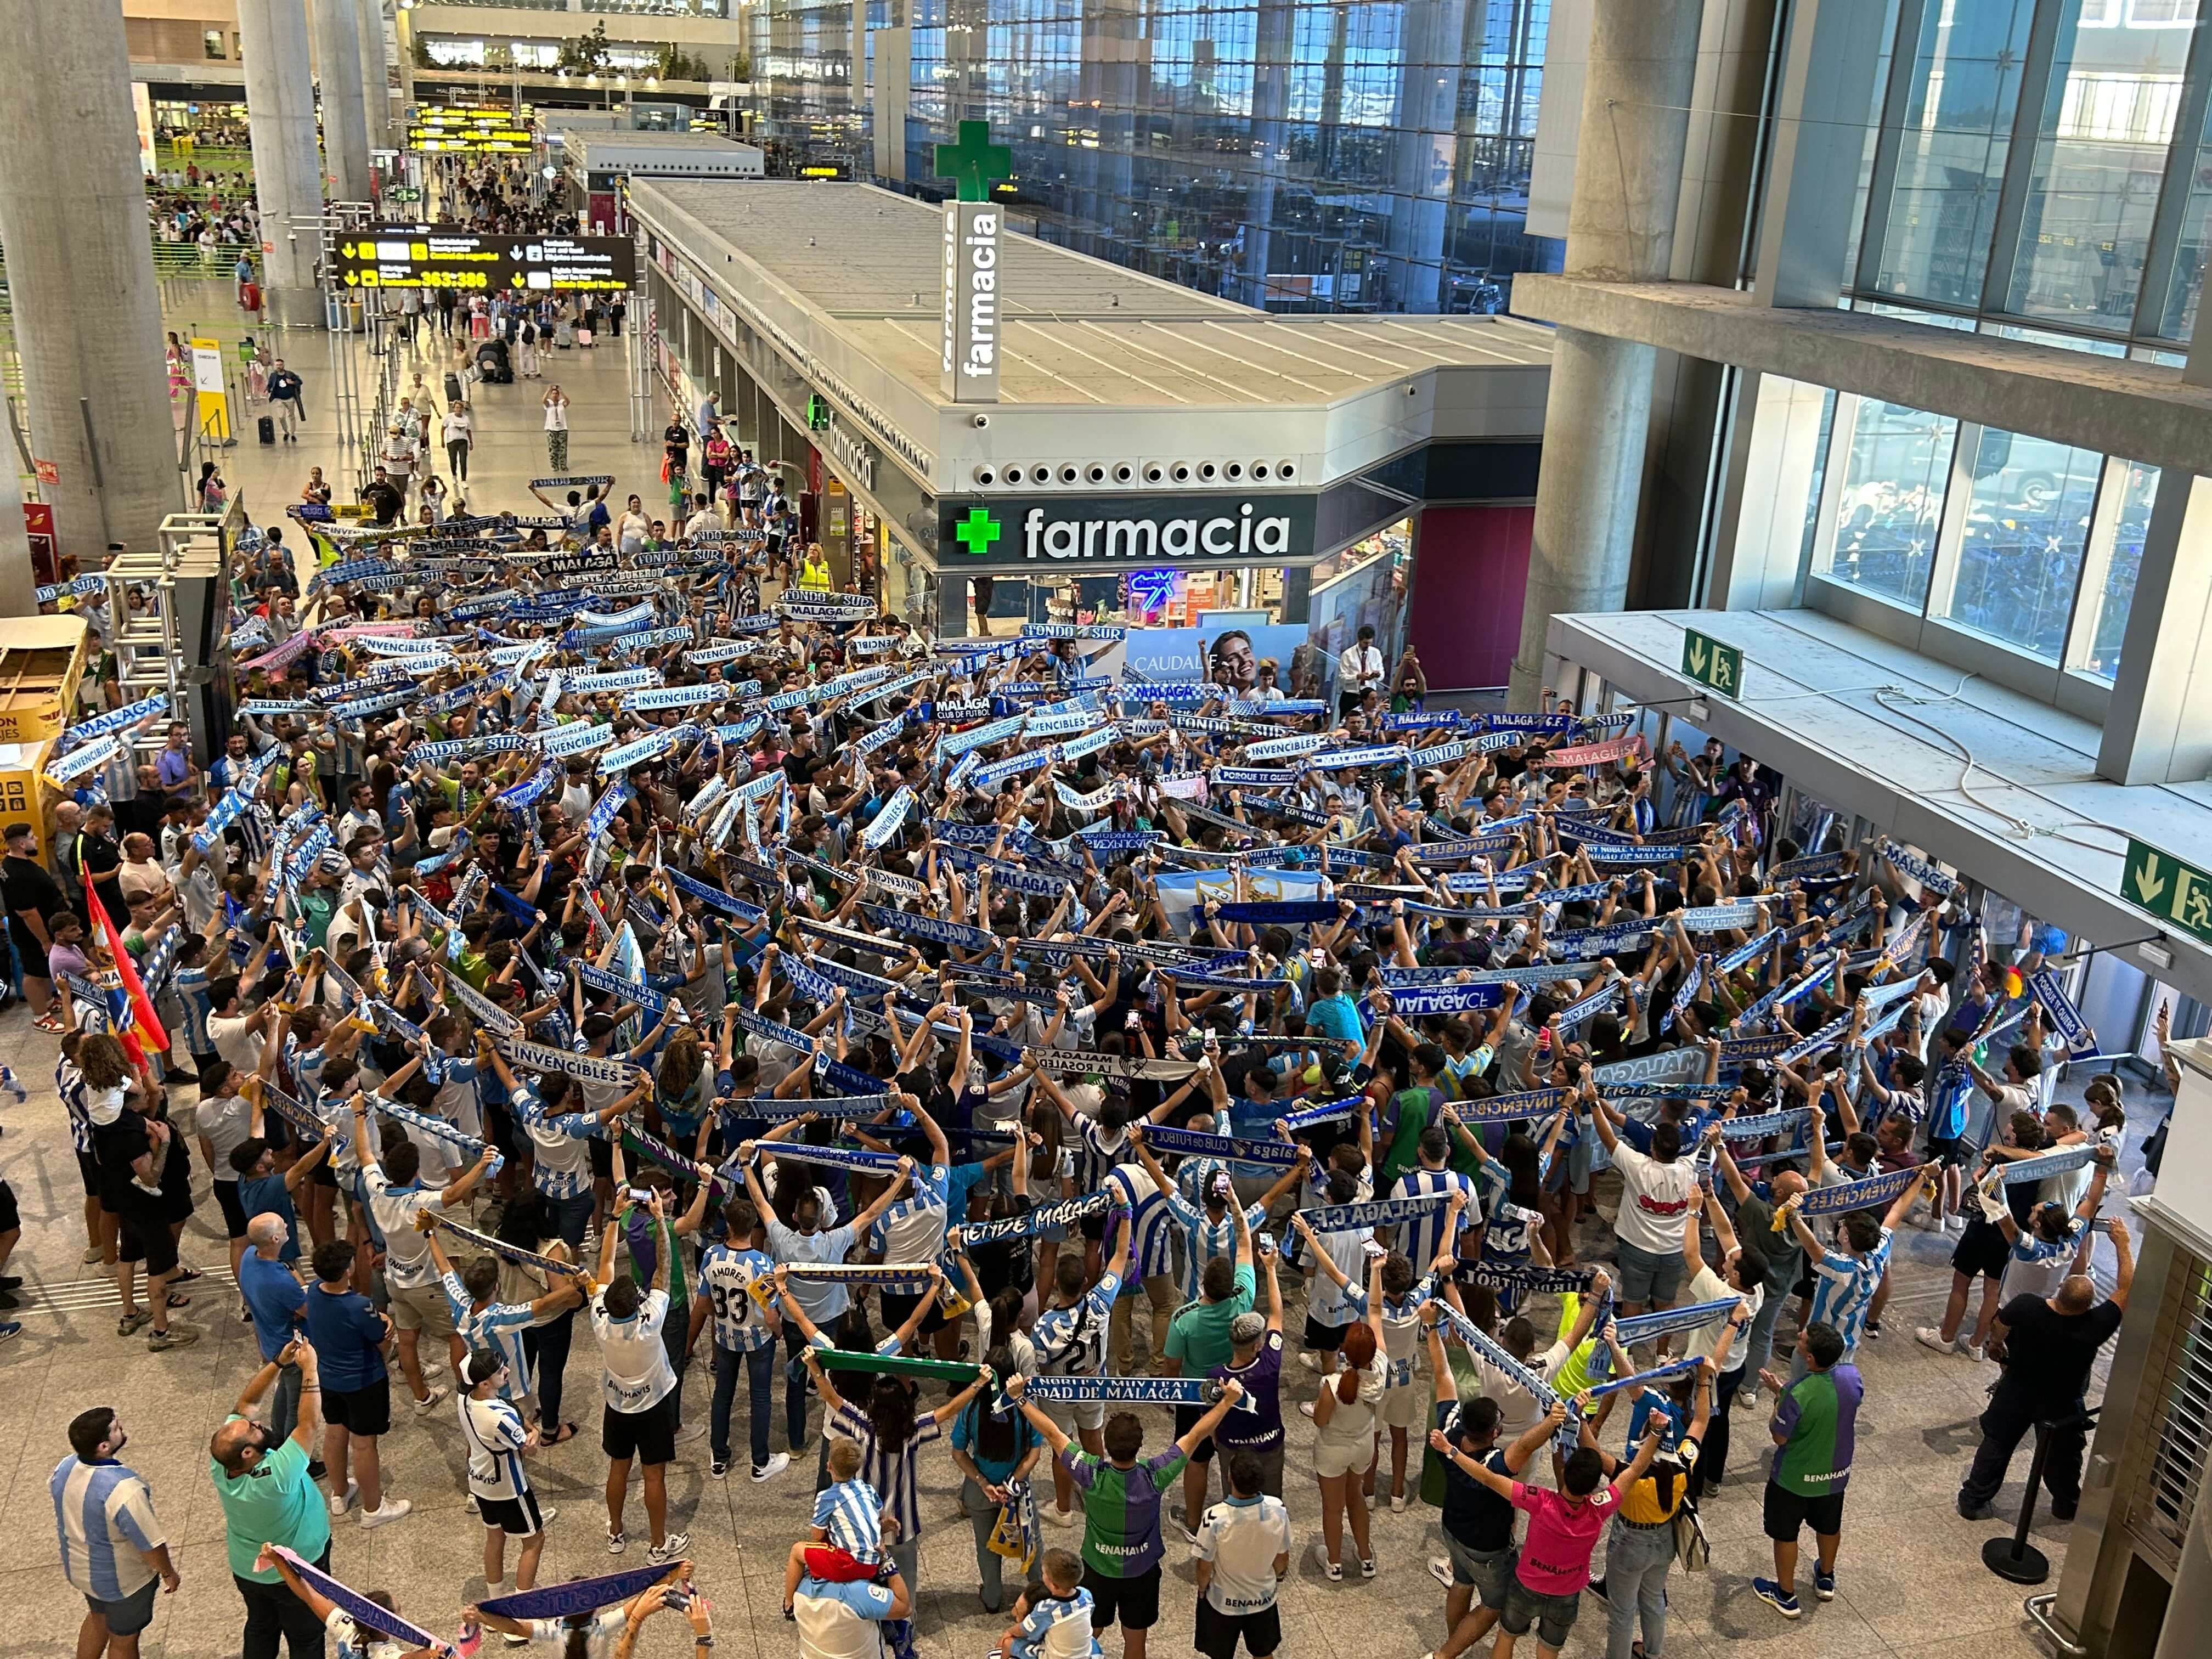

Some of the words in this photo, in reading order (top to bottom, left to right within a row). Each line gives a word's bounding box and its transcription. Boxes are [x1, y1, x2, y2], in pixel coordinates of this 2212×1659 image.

[963, 214, 997, 377] farmacia
[585, 476, 608, 485] SUR
[517, 516, 563, 528] MALAGA
[1025, 503, 1290, 558] farmacia
[553, 556, 614, 571] MALAGA
[638, 552, 678, 565] FONDO
[694, 550, 720, 561] SUR
[591, 584, 644, 595] MALAGA
[785, 590, 826, 602] FONDO
[1028, 625, 1074, 637] FONDO
[1092, 627, 1121, 639] SUR
[377, 657, 447, 673] INVNCIBLES
[1134, 654, 1218, 672] CAUDALE
[579, 674, 647, 690] INVENCIBLES
[822, 682, 849, 697] SUR
[639, 691, 709, 706] INVENCIBLES
[1136, 685, 1193, 698] MALAGA
[936, 697, 990, 712] MALAGA
[76, 698, 161, 737] MALAGA
[965, 709, 990, 718] FUTBOL
[1398, 713, 1431, 724] MALAGA
[1493, 714, 1534, 725] MALAGA
[1596, 714, 1630, 727] SUR
[720, 714, 763, 741] MALAGA
[1177, 714, 1229, 732] FONDO
[488, 737, 524, 749] SUR
[1251, 740, 1317, 755] INVENCIBLES
[1416, 744, 1463, 765] FONDO
[1481, 734, 1508, 751] SUR
[69, 742, 113, 772] INVENCIBLES
[606, 741, 656, 768] INVENCIBLES
[1223, 770, 1257, 781] PORQUE
[1259, 772, 1268, 781] TE
[1887, 843, 1951, 891] MALAGA
[993, 872, 1049, 894] MALAGA
[605, 980, 617, 991] DE
[618, 985, 654, 1007] MALAGA
[2038, 976, 2056, 1001] PORQUE
[2057, 1008, 2076, 1034] QUIERO
[768, 1027, 804, 1049] MALAGA
[514, 1046, 619, 1082] INVENCIBLES
[712, 1269, 747, 1283] AMORES
[712, 1284, 748, 1325] 33
[1079, 1387, 1100, 1399] DE
[1105, 1386, 1183, 1400] MALAGA
[1095, 1542, 1149, 1556] BENAHAVIS
